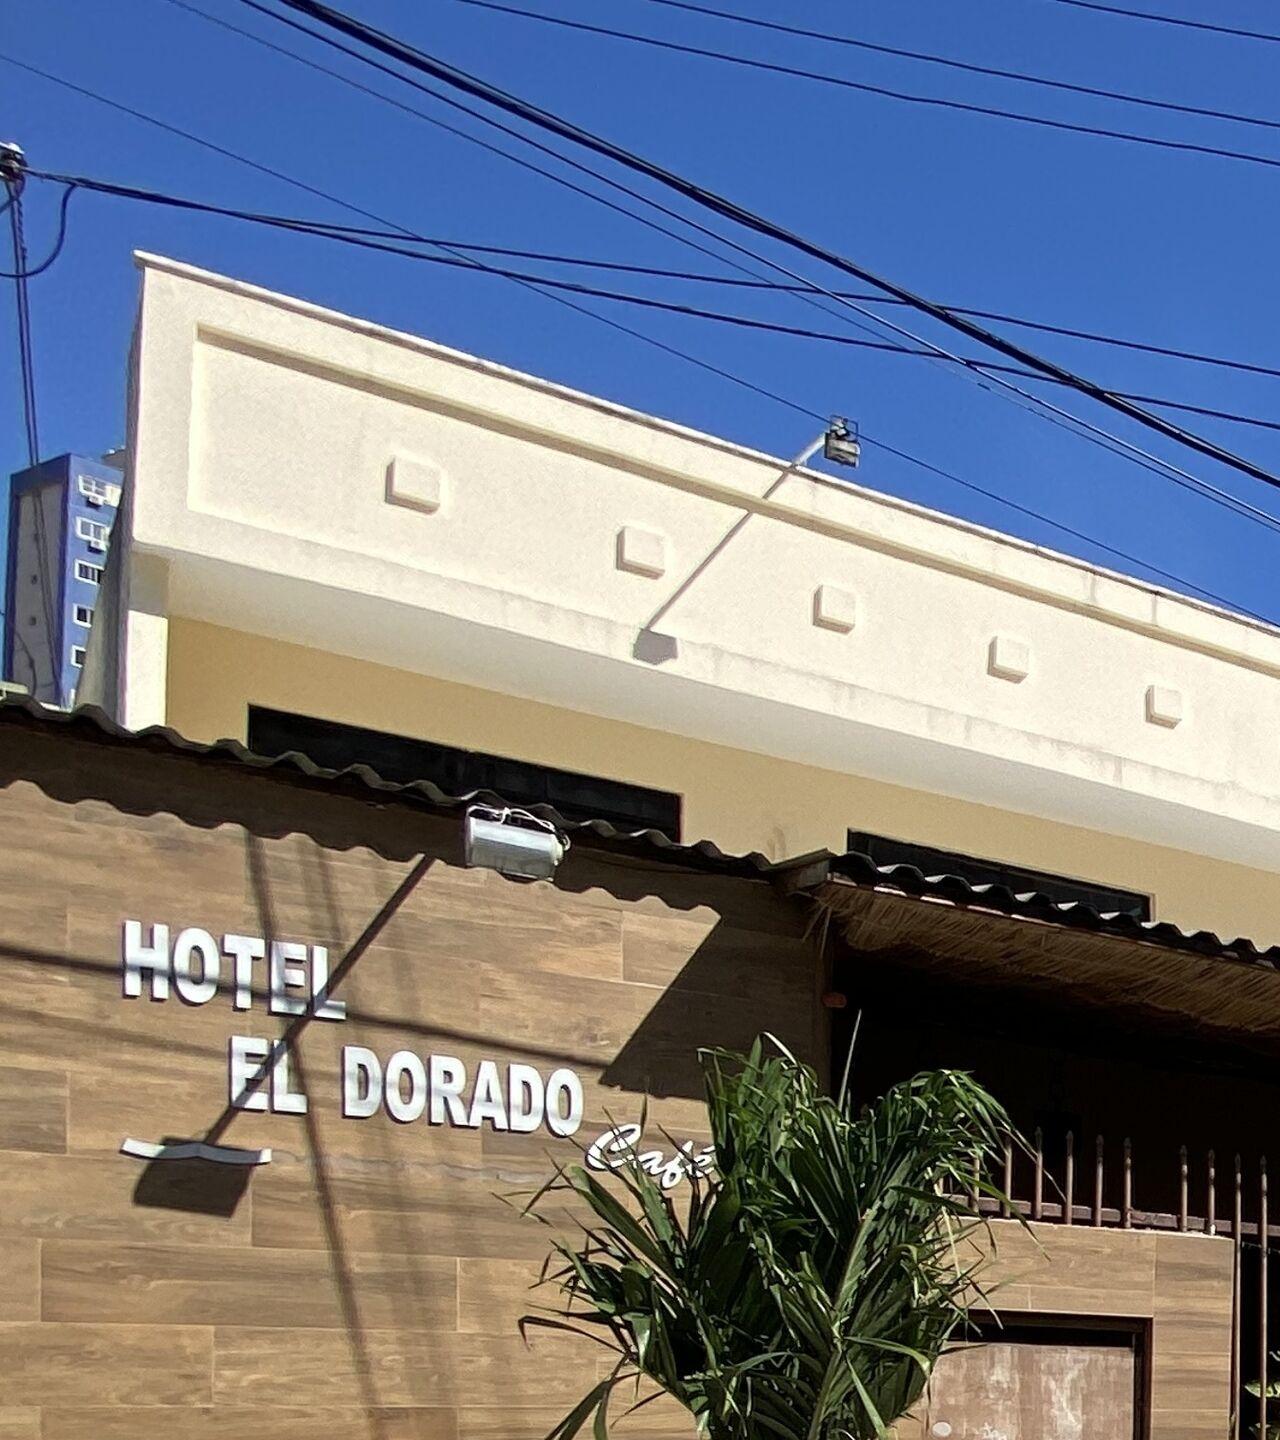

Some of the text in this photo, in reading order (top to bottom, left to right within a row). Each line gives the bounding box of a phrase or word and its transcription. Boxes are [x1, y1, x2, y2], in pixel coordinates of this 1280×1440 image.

[121, 919, 347, 1022] HOTEL
[228, 1035, 584, 1138] EL DORADO
